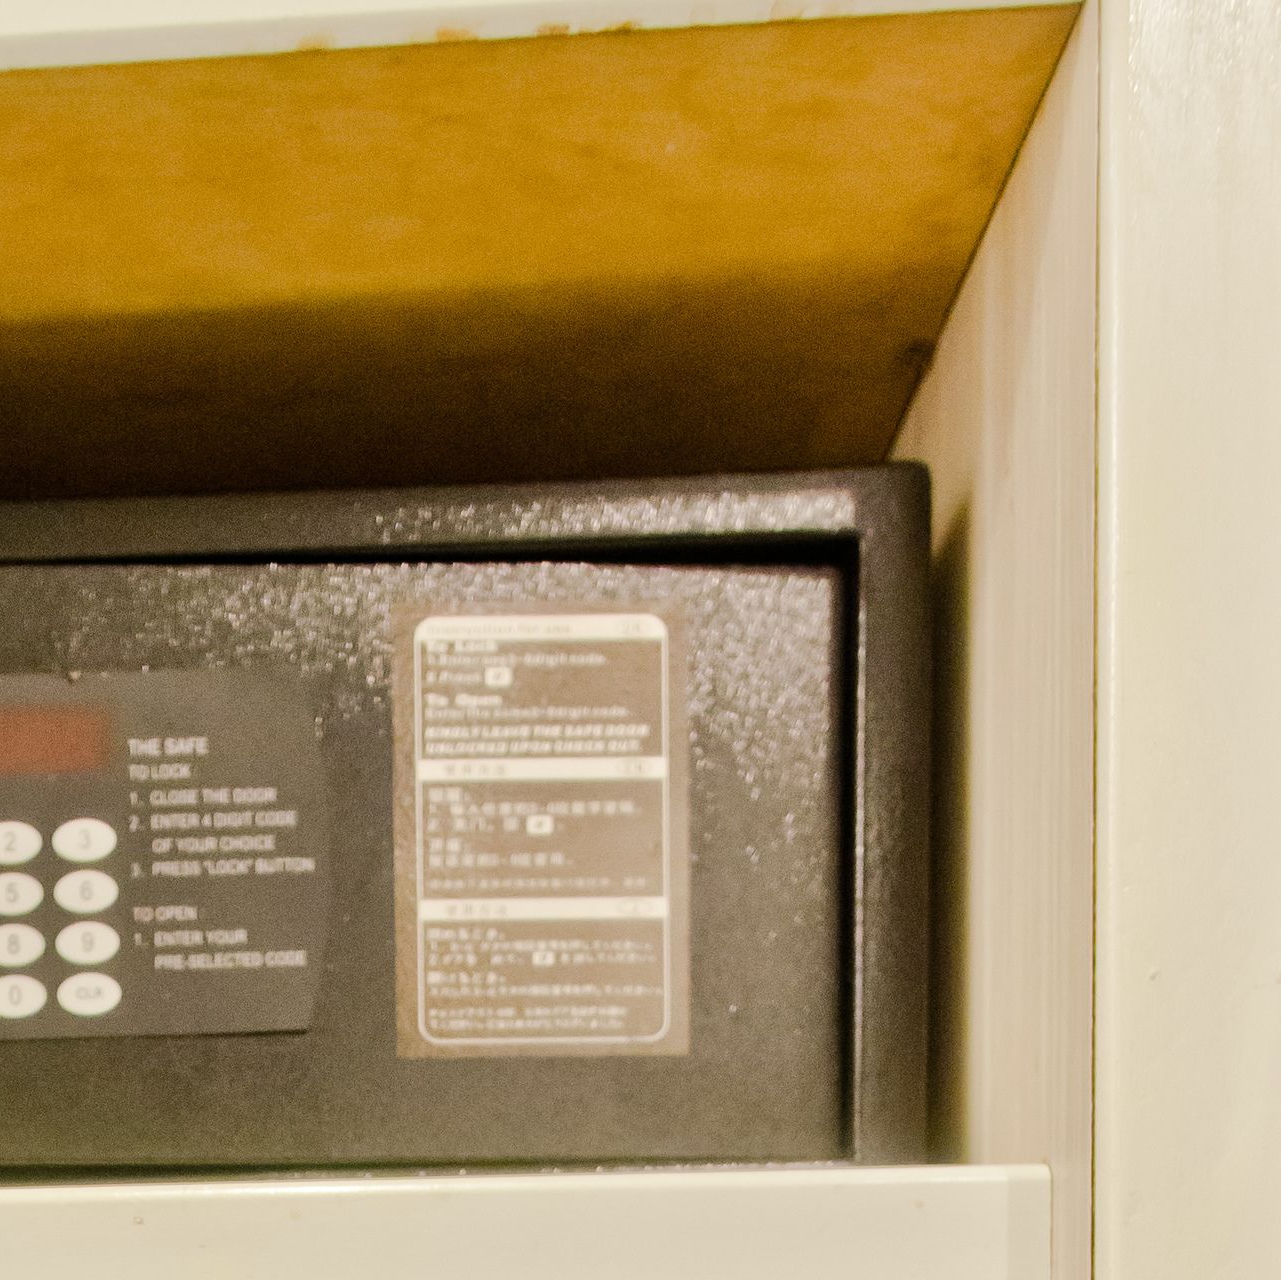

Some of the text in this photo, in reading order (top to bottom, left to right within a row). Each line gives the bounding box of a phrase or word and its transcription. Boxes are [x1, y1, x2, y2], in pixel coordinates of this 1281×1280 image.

[128, 736, 210, 757] THE SAFE
[128, 763, 191, 780] TO LOCK
[149, 789, 199, 806] CLOSE
[201, 788, 230, 804] THE
[232, 787, 278, 804] DOOR
[150, 813, 200, 830] ENTER
[4, 832, 17, 851] 2
[79, 830, 92, 849] 3
[151, 835, 276, 853] OF YOUR CHOICE
[151, 860, 202, 877] PRESS
[255, 857, 316, 875] BUTTON
[5, 883, 19, 903] 5
[79, 880, 94, 900] 6
[133, 905, 198, 922] TO OPEN
[6, 935, 20, 955] 8
[81, 932, 96, 952] 9
[154, 930, 204, 947] ENTER
[205, 928, 248, 946] YOUR
[9, 985, 22, 1006] 0
